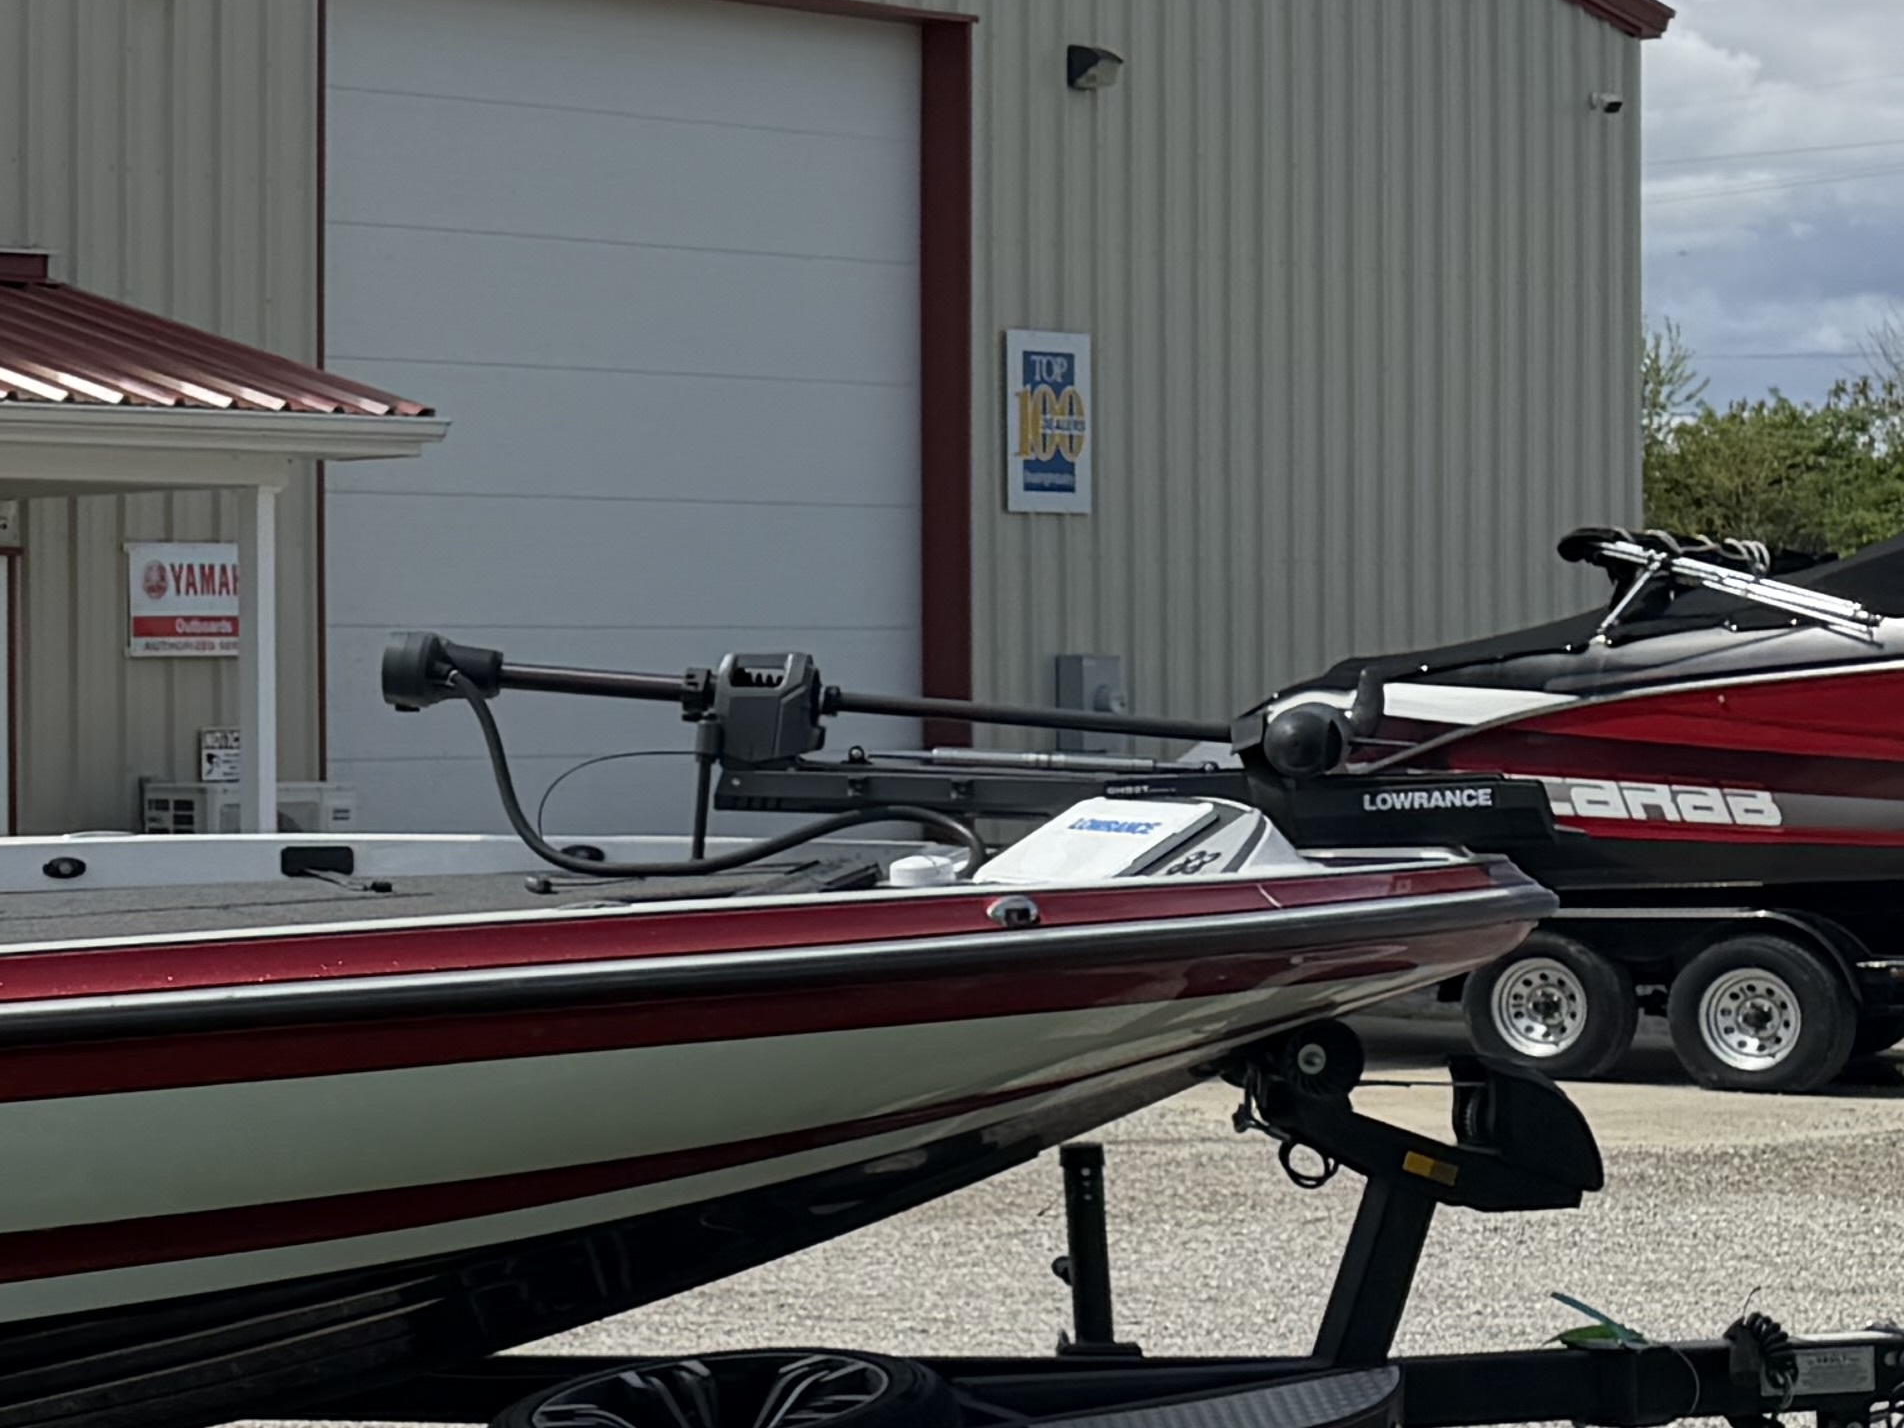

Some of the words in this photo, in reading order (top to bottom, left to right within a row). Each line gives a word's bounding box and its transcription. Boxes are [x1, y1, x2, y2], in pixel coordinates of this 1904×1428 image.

[1029, 355, 1068, 382] TOP
[1014, 384, 1086, 462] 100
[1363, 788, 1493, 811] LOWRANCE
